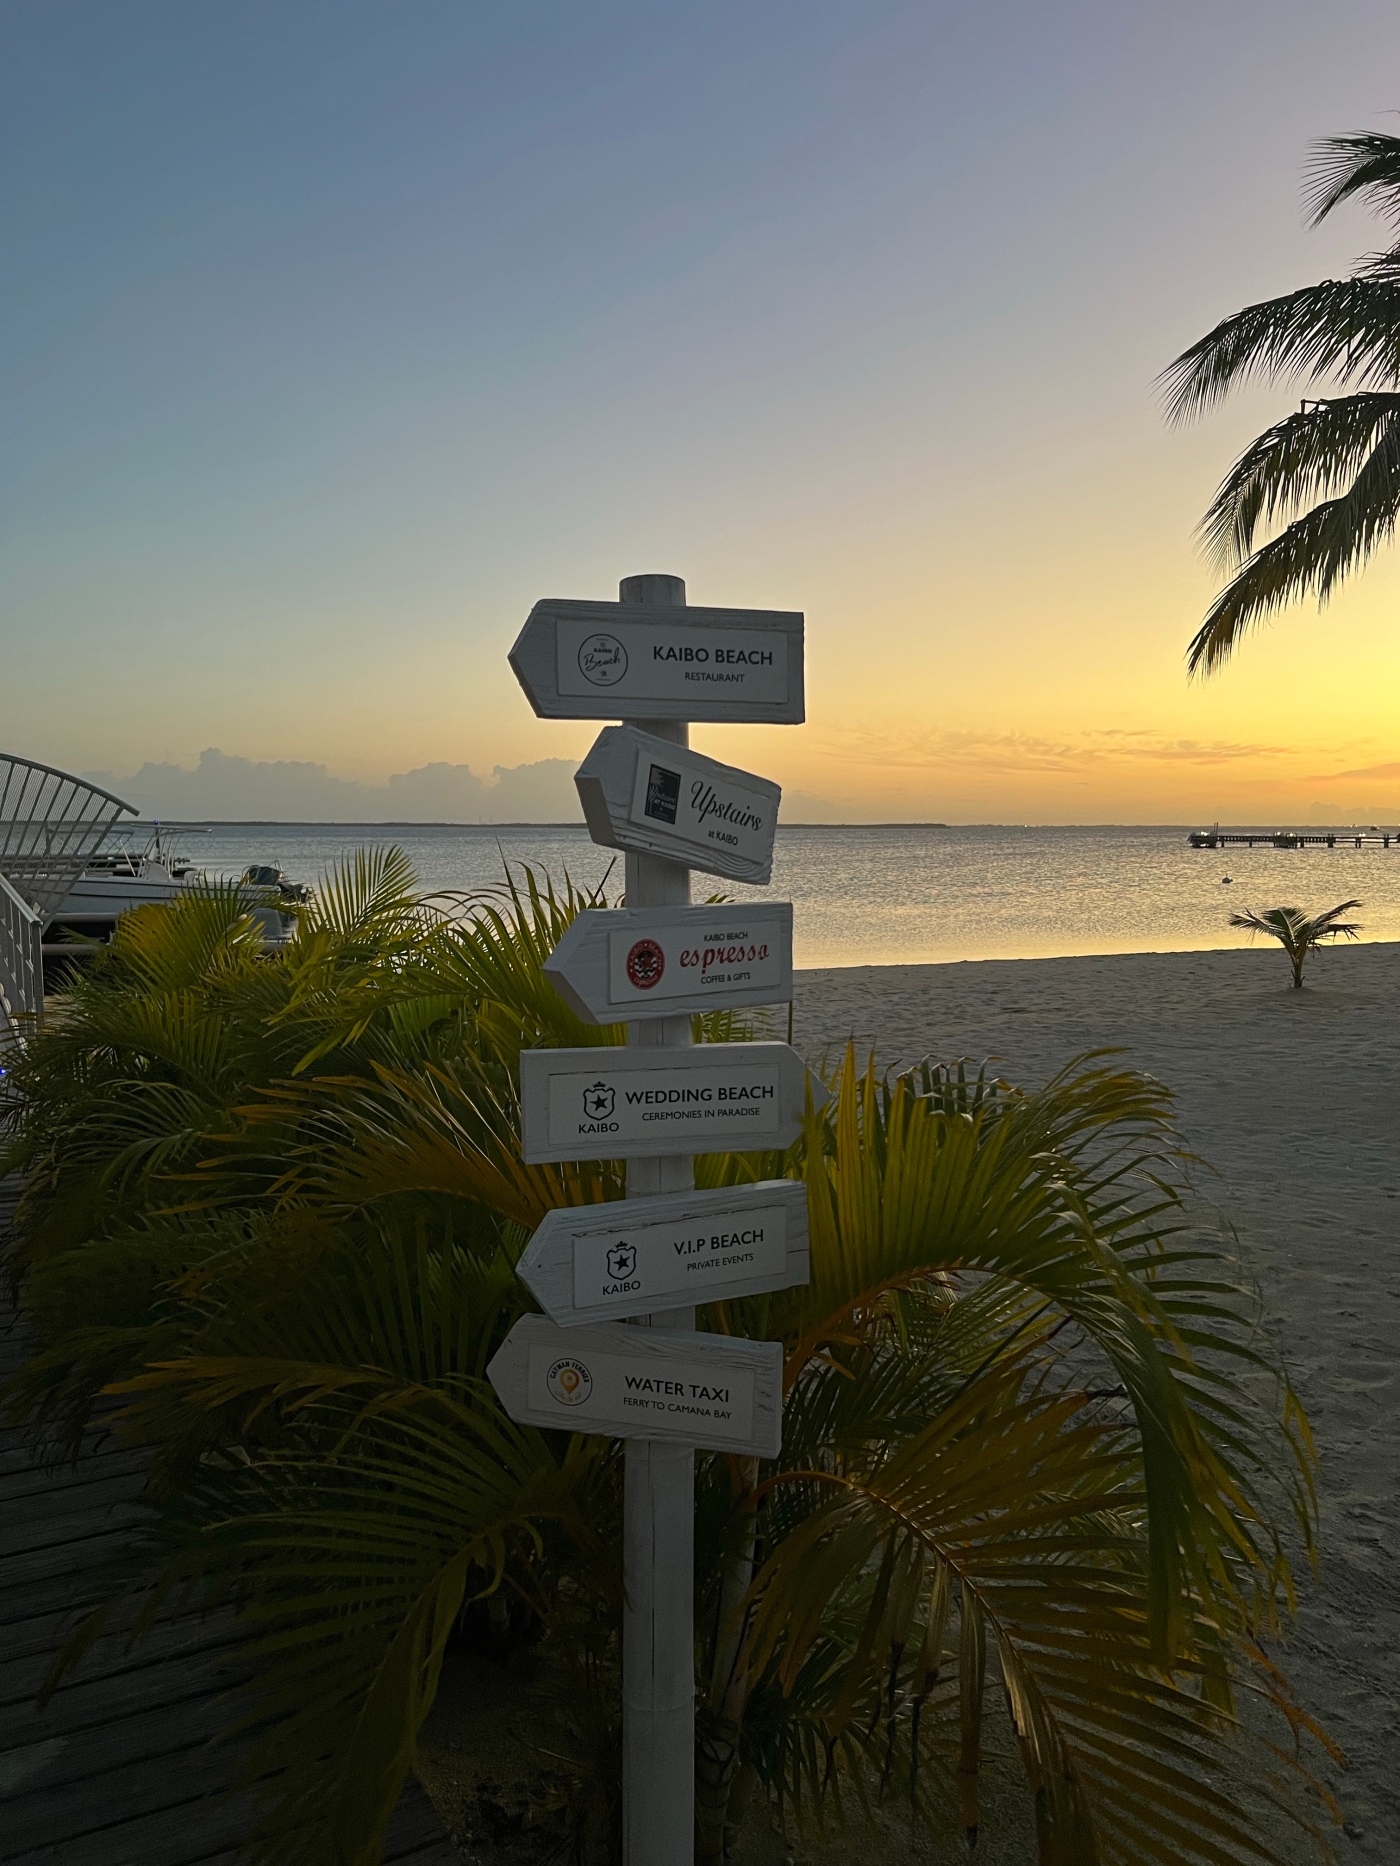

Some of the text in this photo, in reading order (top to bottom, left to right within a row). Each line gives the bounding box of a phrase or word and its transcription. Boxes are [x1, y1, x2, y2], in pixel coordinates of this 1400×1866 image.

[583, 646, 621, 672] Beach
[653, 646, 772, 665] KAIBO BEACH
[685, 672, 745, 683] RESTAURANT
[691, 781, 764, 831] Upstairs
[708, 830, 739, 846] at KAIBO
[704, 932, 748, 942] KAIBO BEACH
[679, 944, 770, 974] espresso
[701, 972, 751, 984] COFFEE & GIFTS
[625, 1085, 774, 1105] WEDDING BEACH
[642, 1107, 760, 1121] CEREMONIES IN PARADISE
[578, 1122, 620, 1134] KAIBO
[674, 1229, 764, 1255] V.I.P BEACH
[687, 1253, 754, 1271] PRIVATE EVENTS
[602, 1280, 641, 1296] KAIBO
[625, 1375, 729, 1403] WATER TAXI
[623, 1397, 732, 1420] FERRY TO CAMANA BAY
